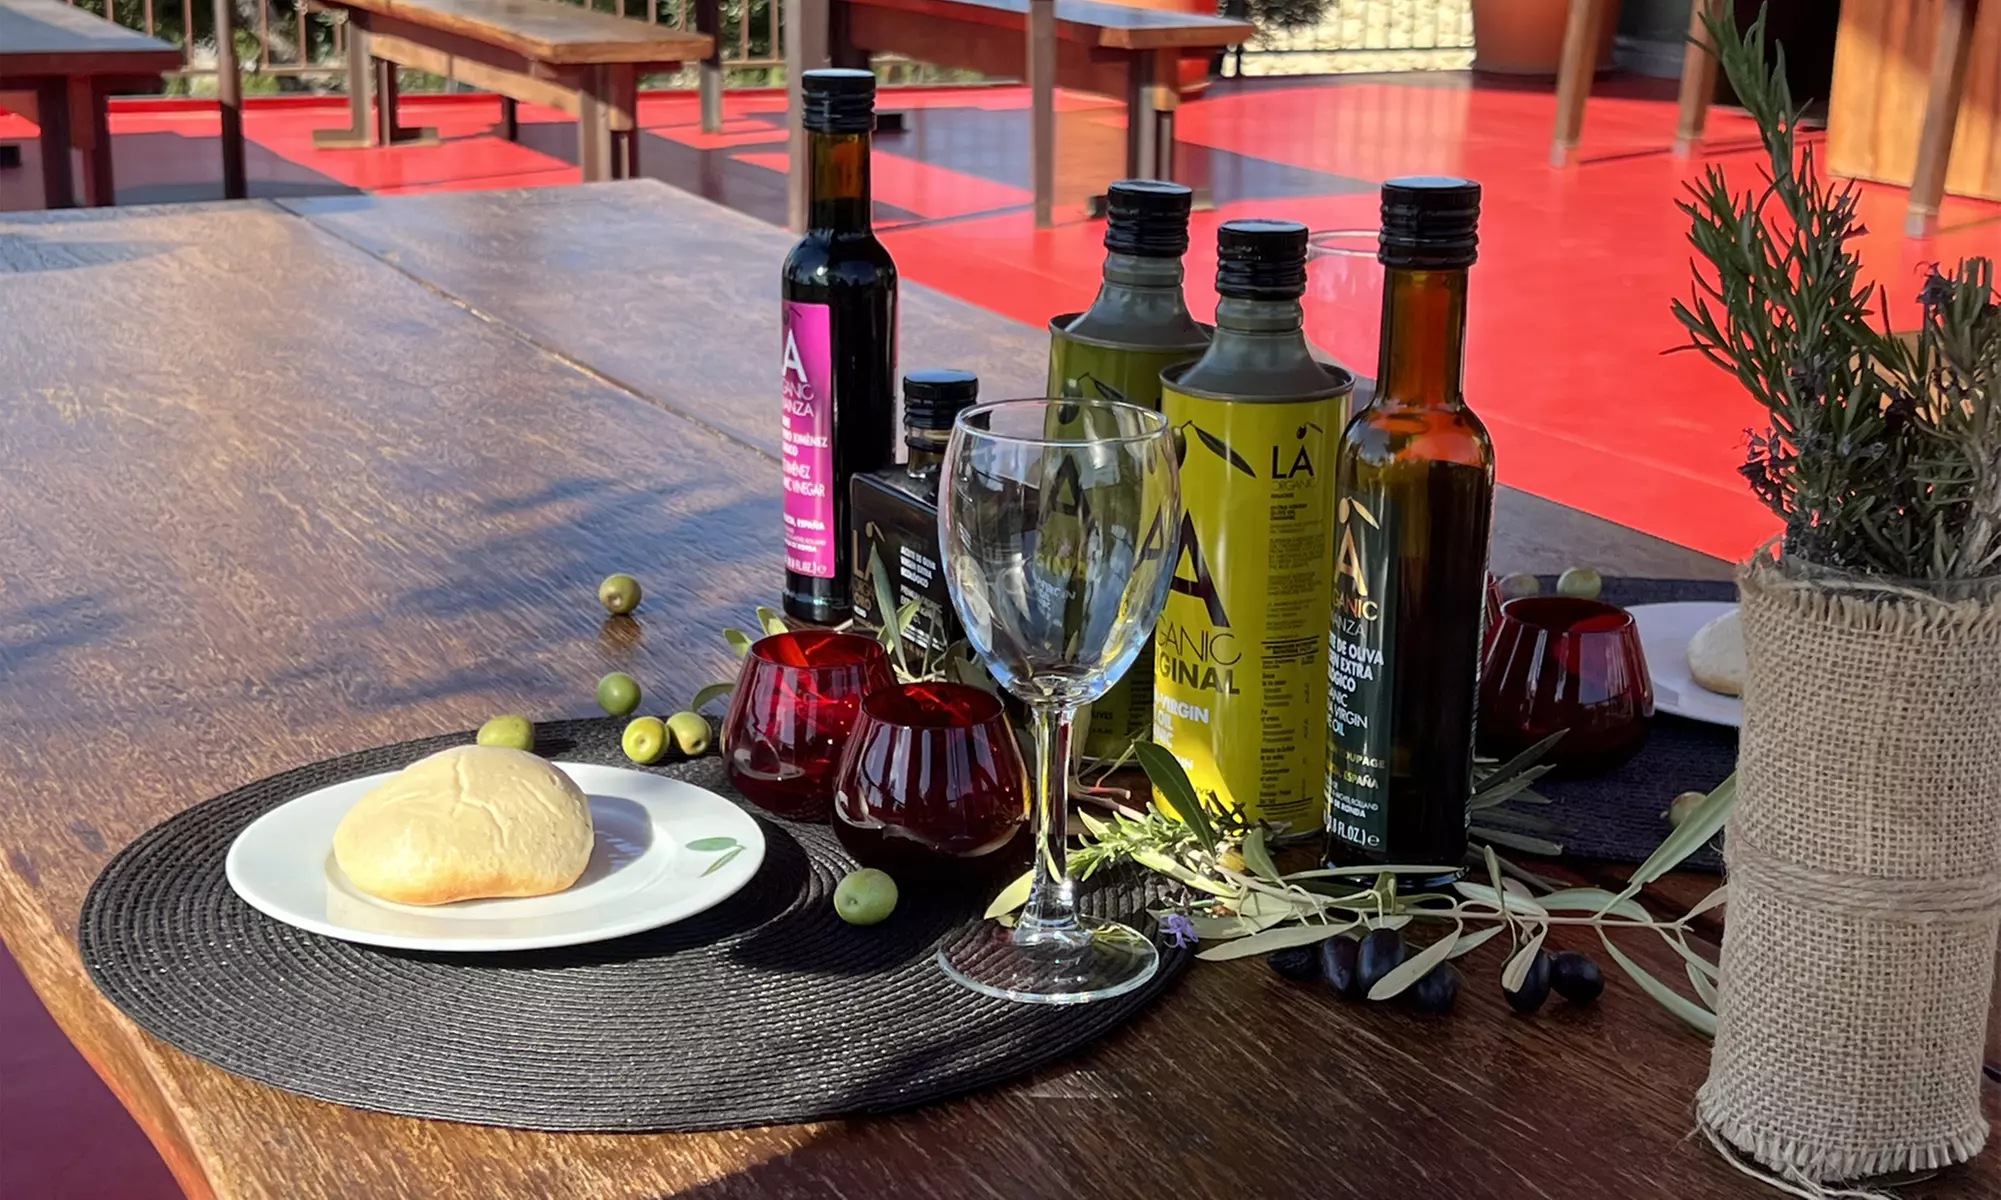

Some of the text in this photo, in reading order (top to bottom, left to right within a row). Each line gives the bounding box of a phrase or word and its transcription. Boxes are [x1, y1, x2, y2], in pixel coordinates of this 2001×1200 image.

[782, 328, 808, 383] A
[1160, 508, 1231, 629] A
[1334, 523, 1369, 597] A
[1331, 612, 1367, 639] ANZA
[1333, 588, 1379, 622] GANIC
[1156, 612, 1242, 666] GANIC
[1336, 636, 1347, 656] DE
[1347, 643, 1385, 667] OLIVA
[1340, 656, 1374, 681] EXTRA
